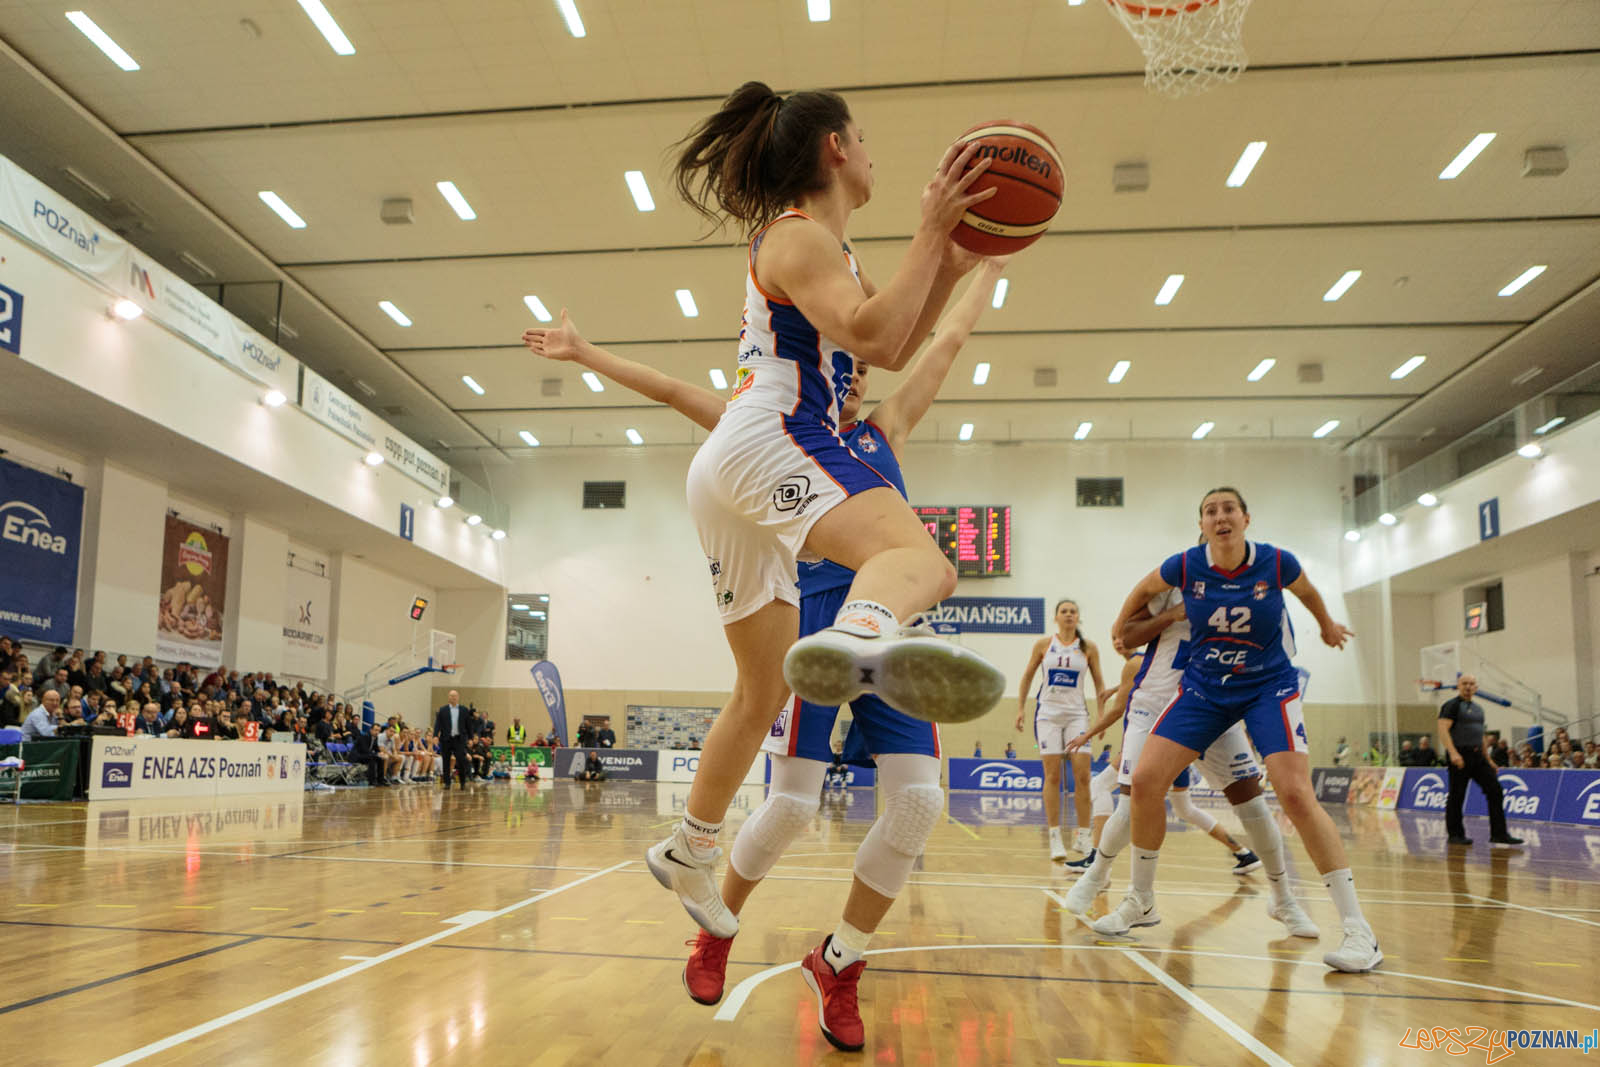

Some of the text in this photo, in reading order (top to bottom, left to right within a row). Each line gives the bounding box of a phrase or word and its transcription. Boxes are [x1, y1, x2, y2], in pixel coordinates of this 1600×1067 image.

[976, 145, 1051, 179] molten
[0, 290, 13, 344] 2
[404, 509, 411, 537] 1
[1482, 503, 1493, 537] 1
[2, 514, 67, 555] Enea
[1208, 606, 1251, 633] 42
[1057, 656, 1071, 667] 11
[1205, 647, 1248, 665] PGE
[118, 713, 126, 729] 5
[126, 715, 135, 731] 5
[246, 722, 256, 738] 5
[142, 757, 261, 779] ENEA AZS Poznań
[598, 756, 643, 766] VENIDA
[109, 773, 129, 782] Enea
[979, 771, 1043, 789] Enea
[1502, 789, 1540, 815] nea
